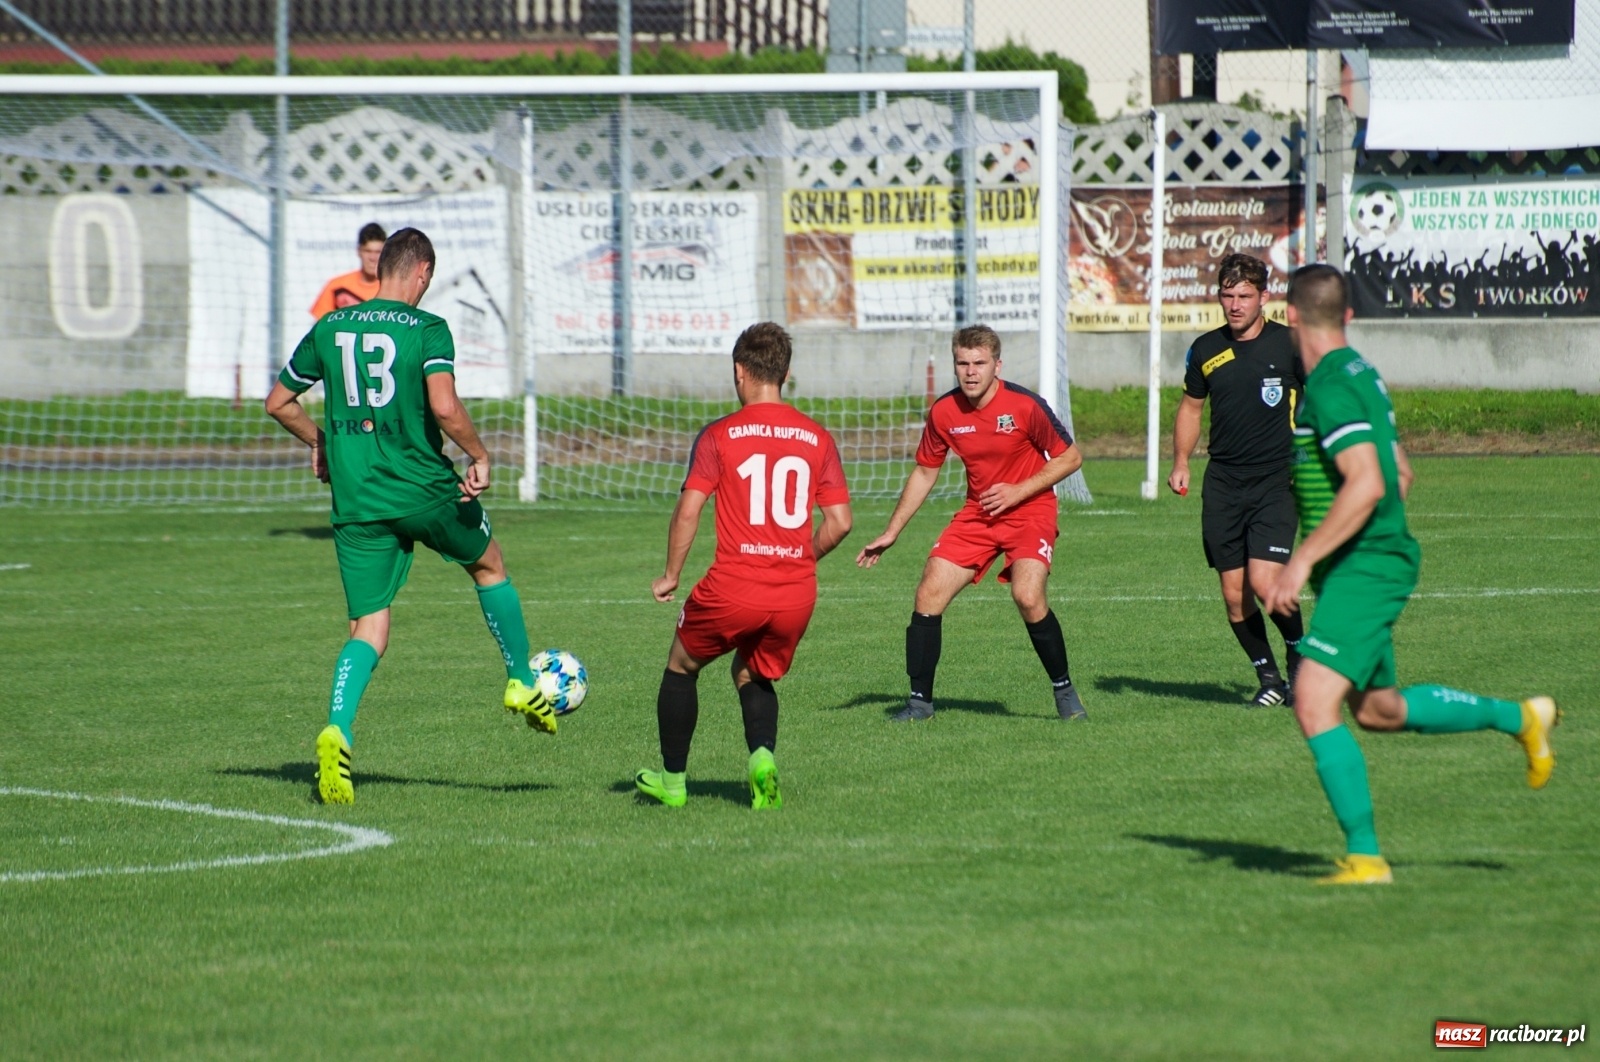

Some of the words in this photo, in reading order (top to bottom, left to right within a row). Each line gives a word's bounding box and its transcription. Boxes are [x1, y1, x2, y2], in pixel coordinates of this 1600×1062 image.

[537, 201, 612, 218] USŁUG
[790, 187, 1040, 224] OKNA-DRZWI-SHODY
[1409, 190, 1462, 209] JEDEN
[1467, 190, 1488, 207] ZA
[1494, 189, 1600, 207] WSZYSTKICH
[1412, 213, 1489, 231] WSZYSCY
[1495, 213, 1515, 230] ZA
[1521, 211, 1598, 230] JEDNEGO
[1201, 225, 1273, 258] Gąska
[1385, 282, 1458, 308] LKS
[1474, 280, 1589, 306] TWORKÓW
[335, 331, 397, 408] 13
[728, 424, 772, 440] GRANICA
[774, 426, 818, 447] RUPTAWA
[736, 453, 811, 530] 10
